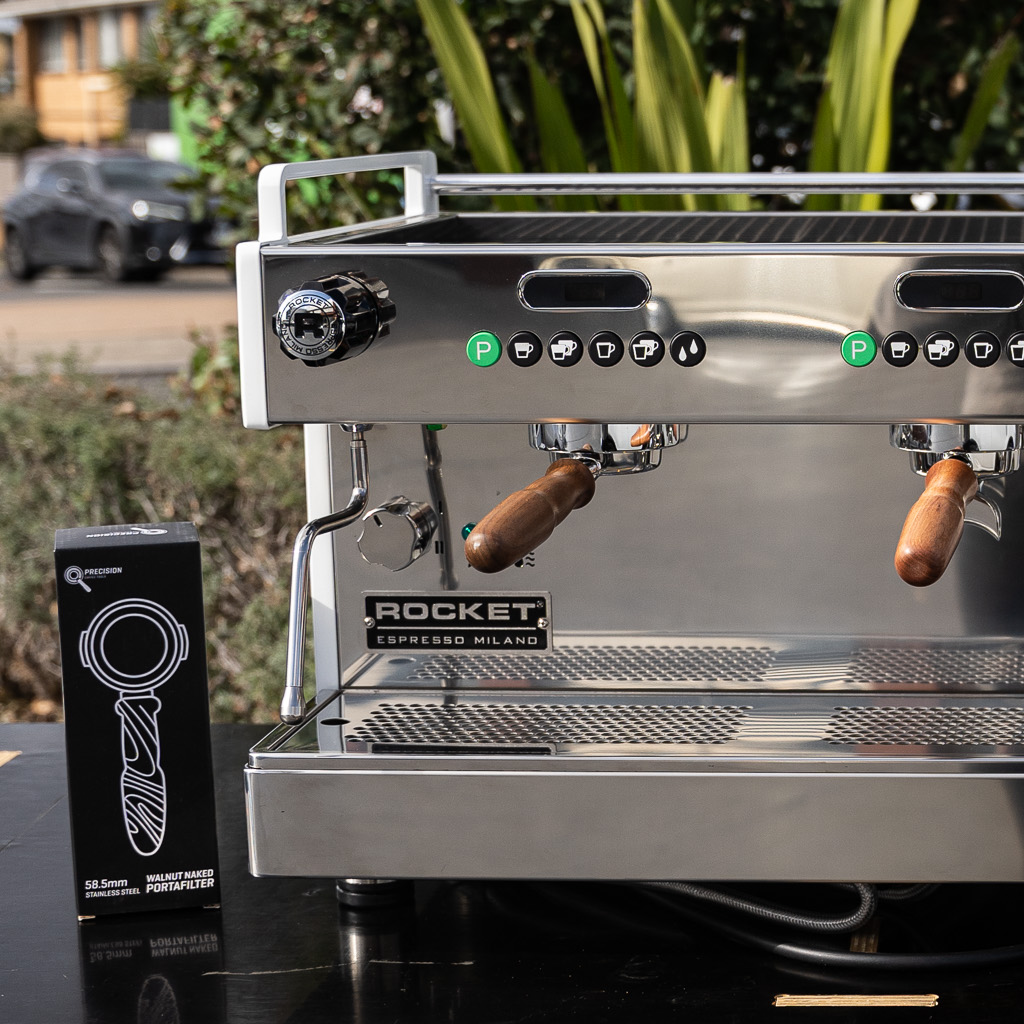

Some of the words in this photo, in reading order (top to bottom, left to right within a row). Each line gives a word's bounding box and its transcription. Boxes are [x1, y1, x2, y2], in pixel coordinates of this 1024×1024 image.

[288, 296, 330, 310] ROCKET
[295, 313, 325, 339] R
[476, 341, 492, 361] P
[851, 340, 867, 360] P
[84, 567, 123, 576] PRECISION
[375, 602, 536, 621] ROCKET
[377, 635, 465, 645] ESPRESSO
[474, 636, 538, 645] MILANO
[146, 872, 183, 883] WALNUT
[185, 868, 214, 879] NAKED
[85, 878, 128, 890] 58.5mm
[146, 877, 215, 894] PORTAFILTER
[85, 889, 121, 898] STAINLESS
[121, 887, 141, 896] STEEL
